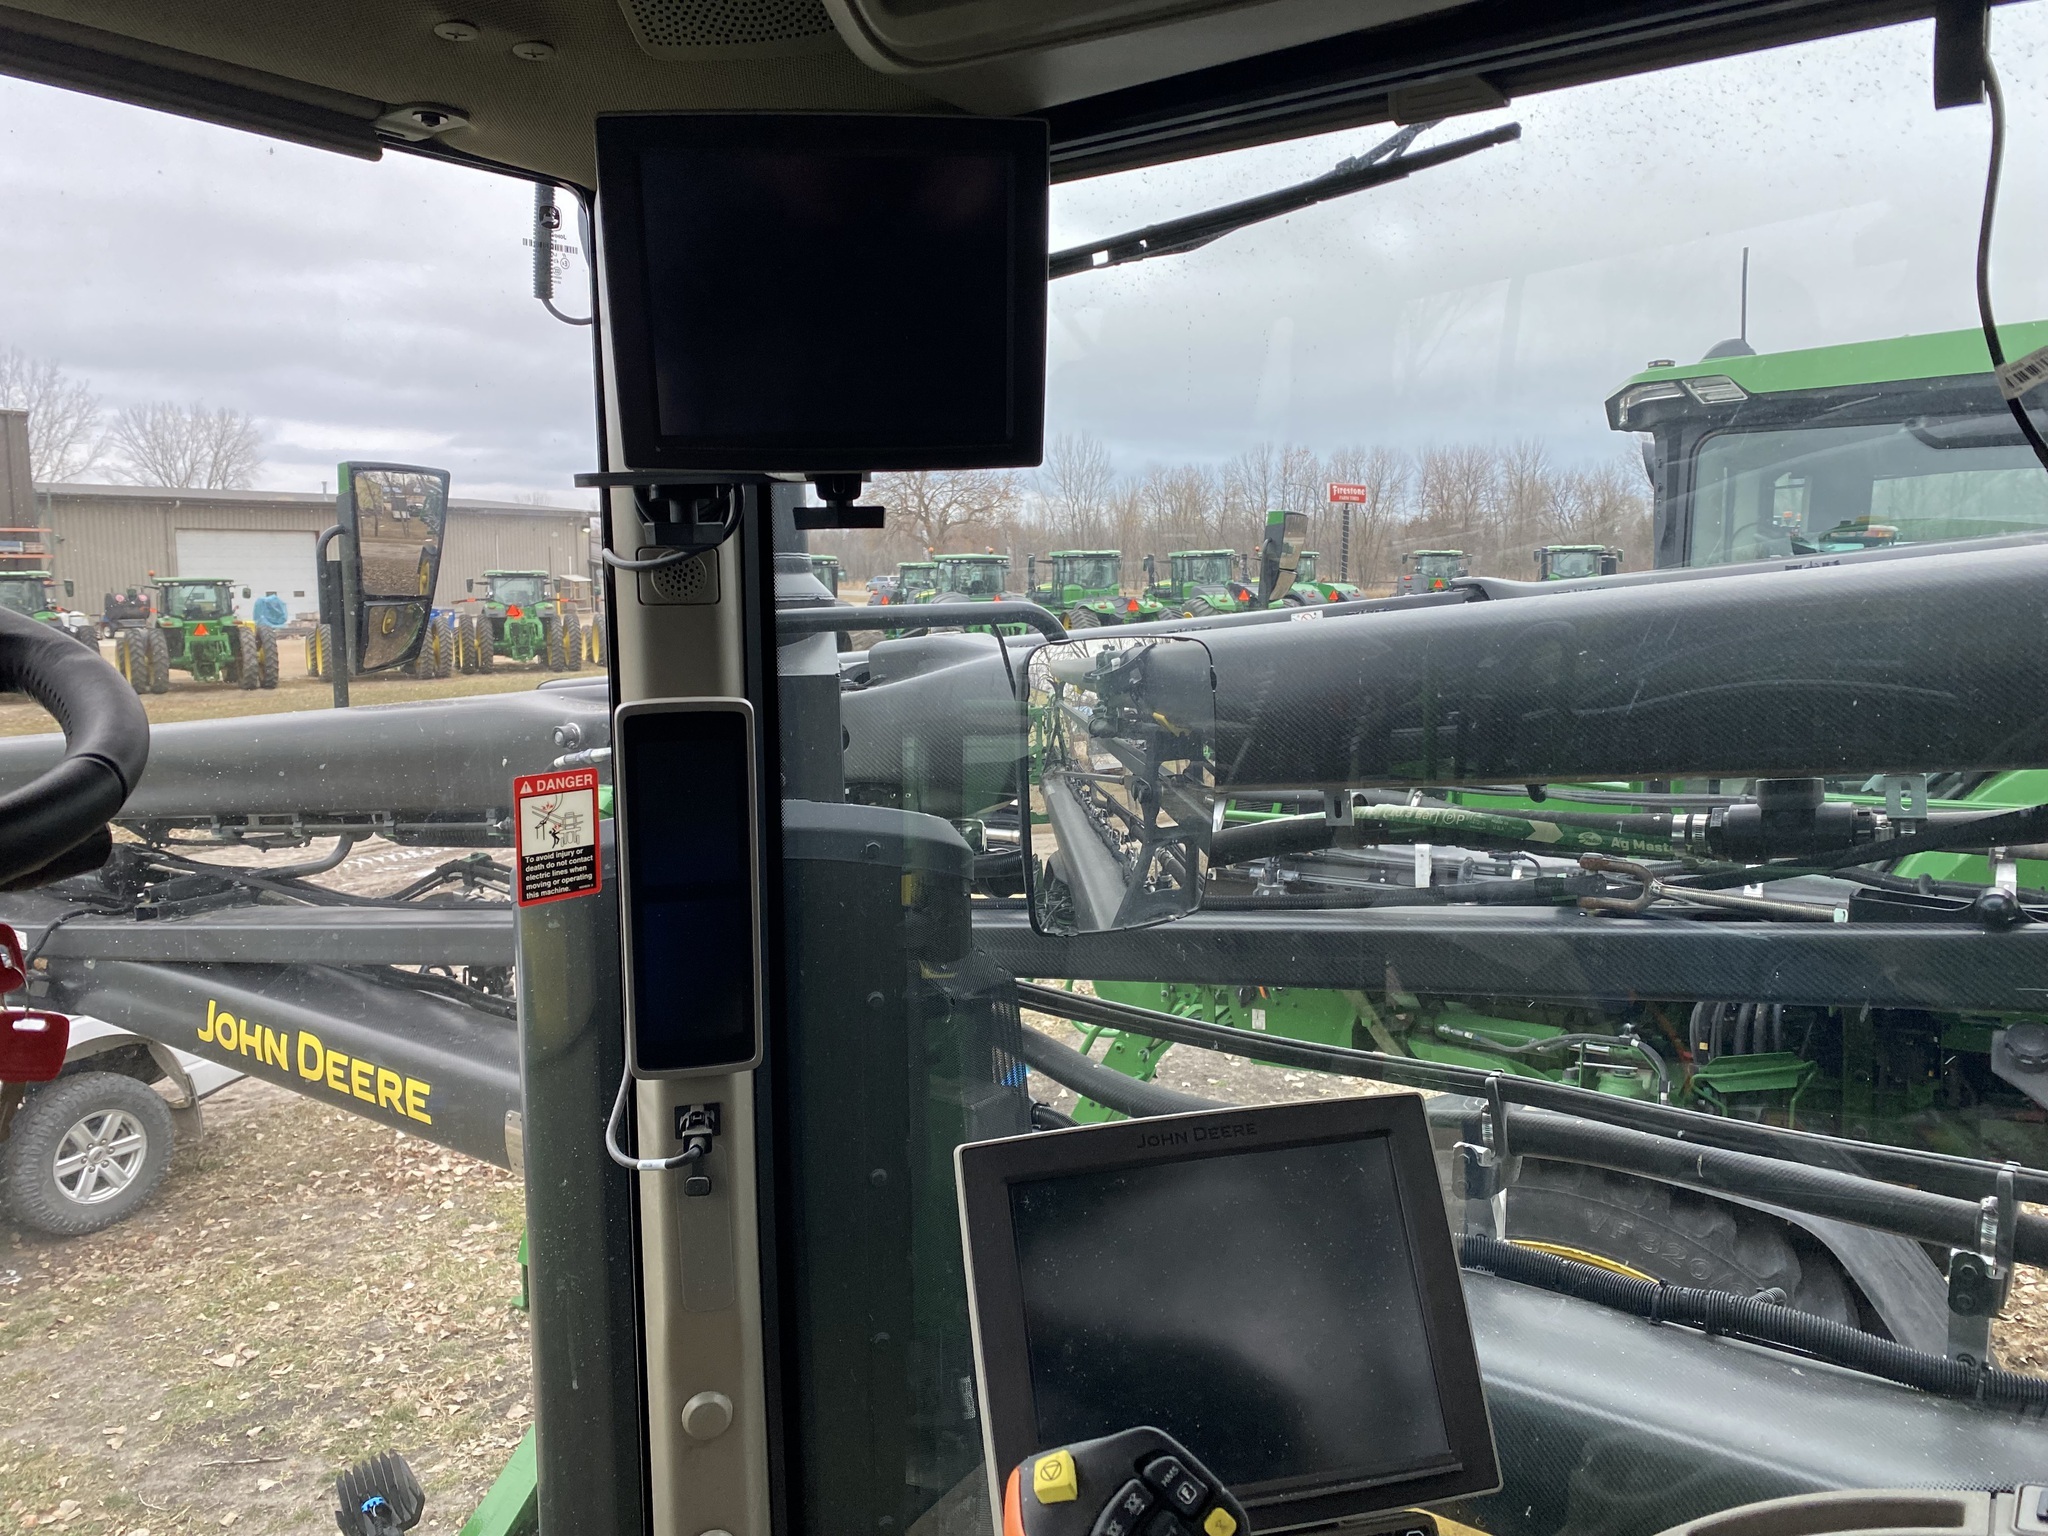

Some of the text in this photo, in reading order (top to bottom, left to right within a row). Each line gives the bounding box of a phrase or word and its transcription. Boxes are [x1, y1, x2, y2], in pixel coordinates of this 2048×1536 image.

[1332, 485, 1365, 496] Firestone
[536, 774, 593, 792] DANGER
[1611, 837, 1630, 851] Ag
[525, 856, 534, 864] To
[535, 853, 555, 862] avoid
[555, 849, 575, 859] injury
[525, 854, 594, 873] death do not contact
[525, 864, 588, 882] electric lines when
[526, 872, 593, 891] moving or operating
[526, 890, 540, 900] this
[540, 885, 571, 898] machine.
[197, 1000, 432, 1125] JOHN DEERE
[1137, 1123, 1258, 1149] JOHN DEERE
[1584, 1207, 1635, 1239] VF
